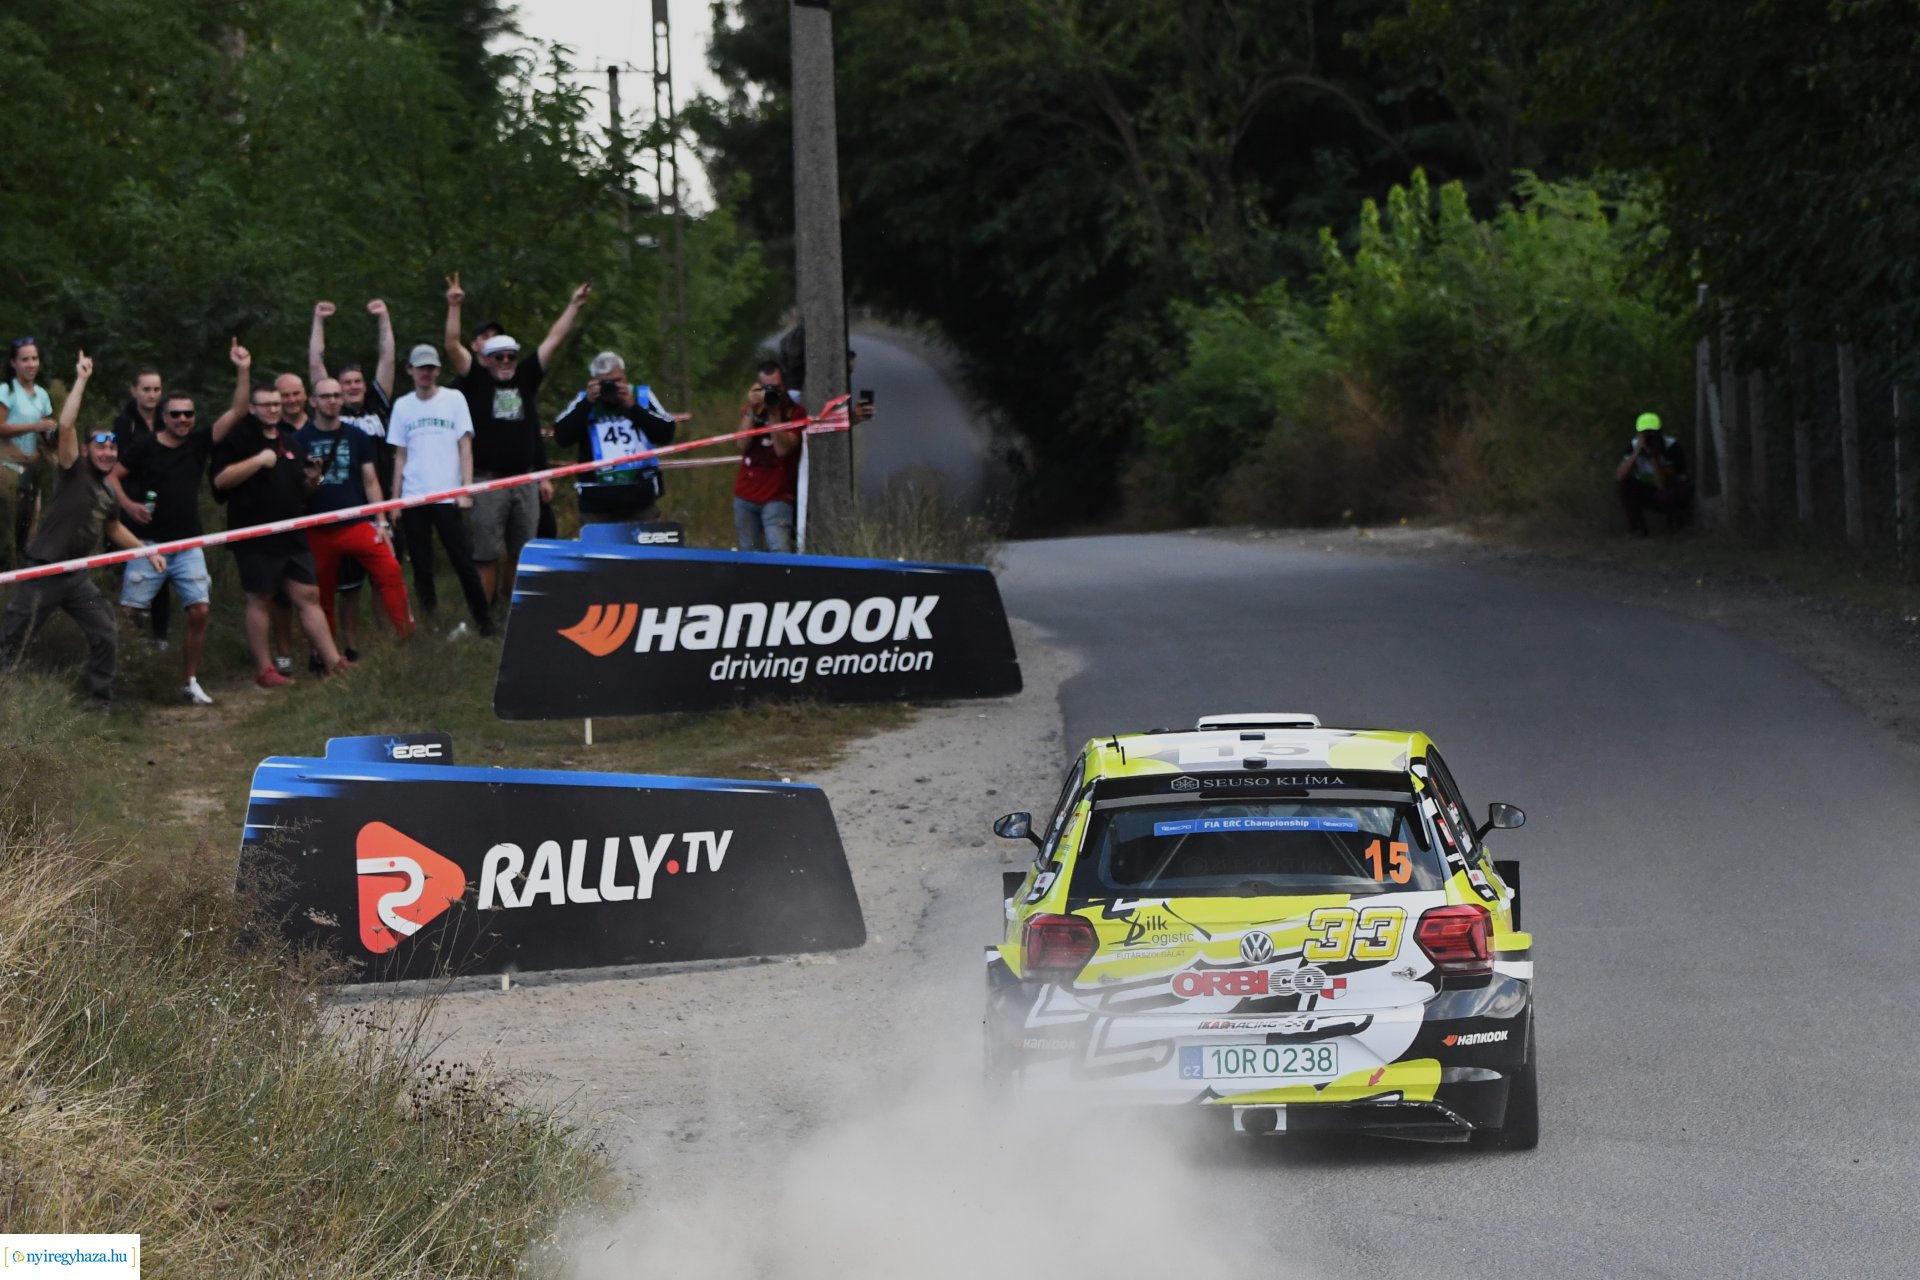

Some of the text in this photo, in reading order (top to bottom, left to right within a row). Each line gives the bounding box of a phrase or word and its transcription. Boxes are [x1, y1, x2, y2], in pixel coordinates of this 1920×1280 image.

[709, 646, 934, 684] driving emotion
[393, 743, 442, 759] ERC
[1203, 774, 1345, 788] SEUSO KLÍMA
[1204, 818, 1310, 829] FIA ERC Championship
[1364, 839, 1413, 884] 15
[1302, 906, 1409, 963] 33
[1183, 1065, 1201, 1077] CZ
